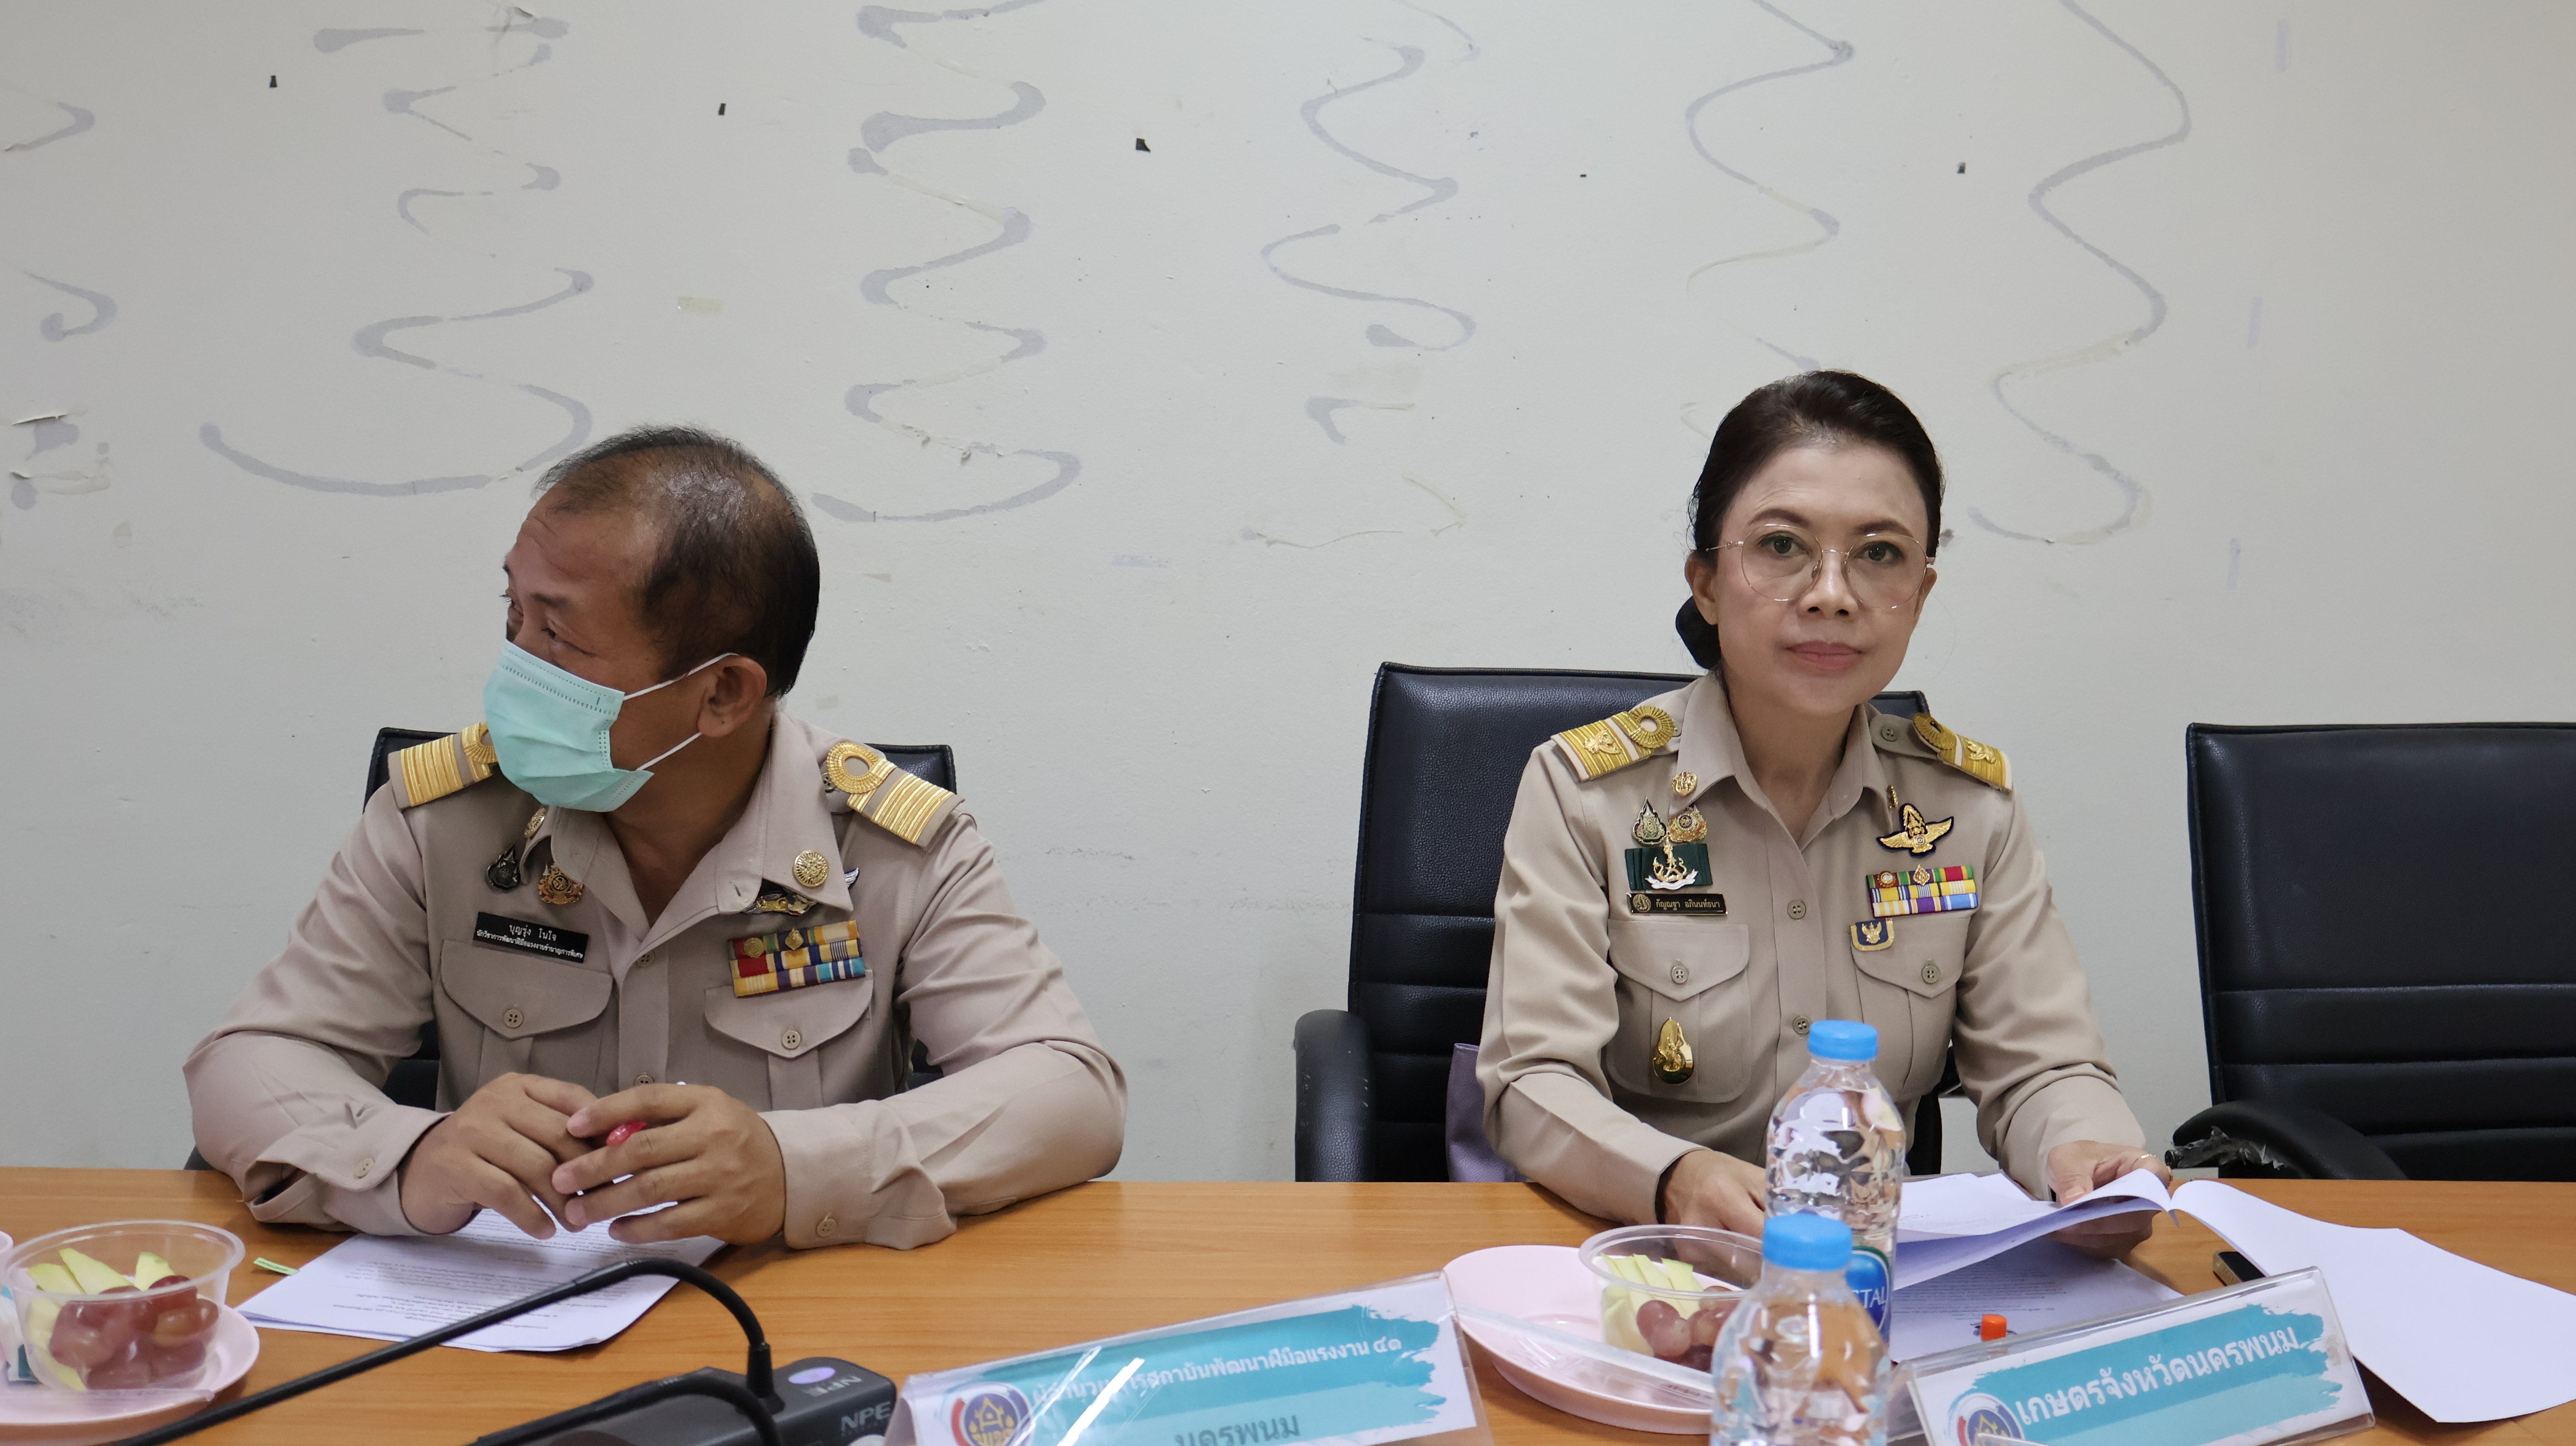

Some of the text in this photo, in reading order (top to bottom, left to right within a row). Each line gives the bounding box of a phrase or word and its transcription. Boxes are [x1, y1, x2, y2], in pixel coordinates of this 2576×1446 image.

[1853, 1287, 1886, 1309] TAL
[1373, 1336, 1402, 1353] ๔๑
[2015, 1327, 2300, 1425] เกษตรจังหวัดนครพนม
[841, 1401, 890, 1433] NPE
[1175, 1415, 1300, 1446] นครพนม
